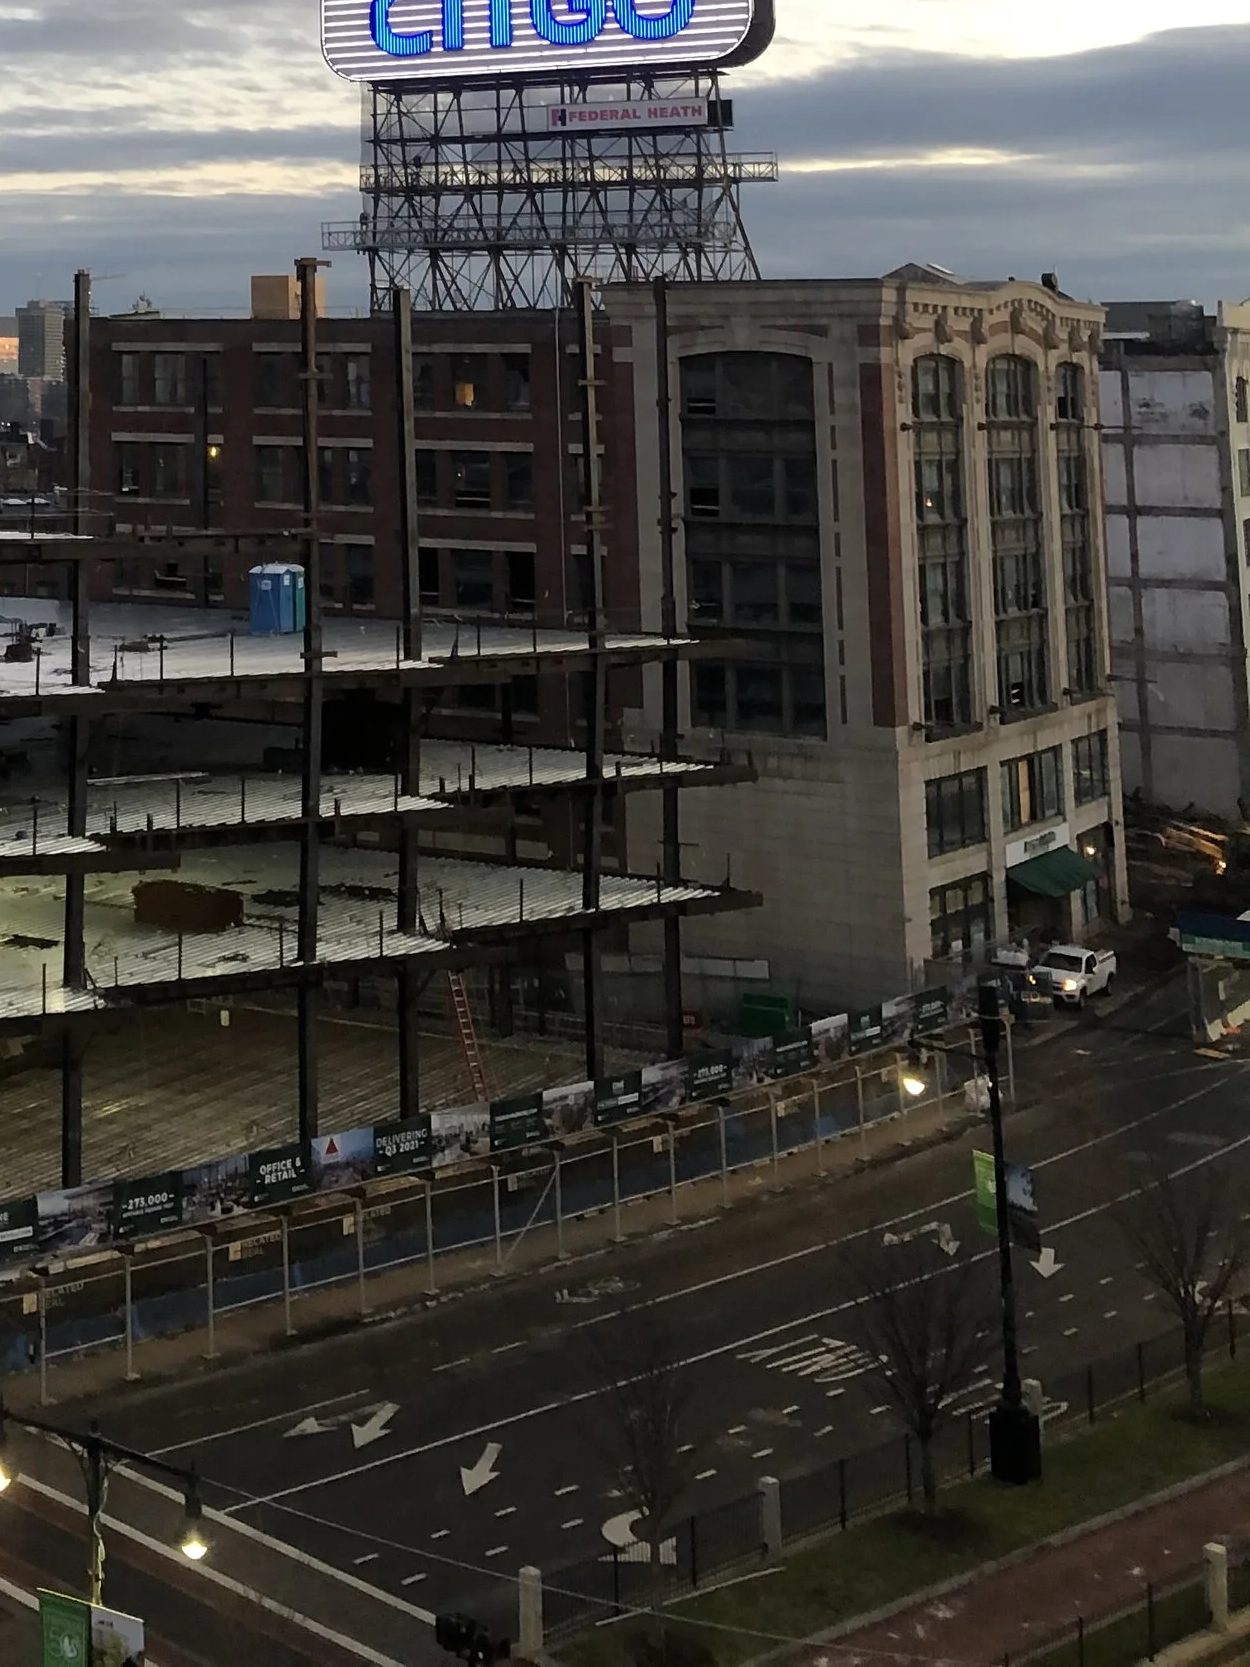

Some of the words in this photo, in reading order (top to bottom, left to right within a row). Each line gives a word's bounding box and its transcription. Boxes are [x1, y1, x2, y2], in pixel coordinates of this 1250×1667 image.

[569, 108, 641, 123] FEDERAL
[647, 105, 702, 119] HEATH
[375, 1128, 429, 1149] DELIVERING
[399, 1140, 419, 1153] 2021
[259, 1159, 293, 1175] OFFICE
[264, 1167, 297, 1185] RETAIL
